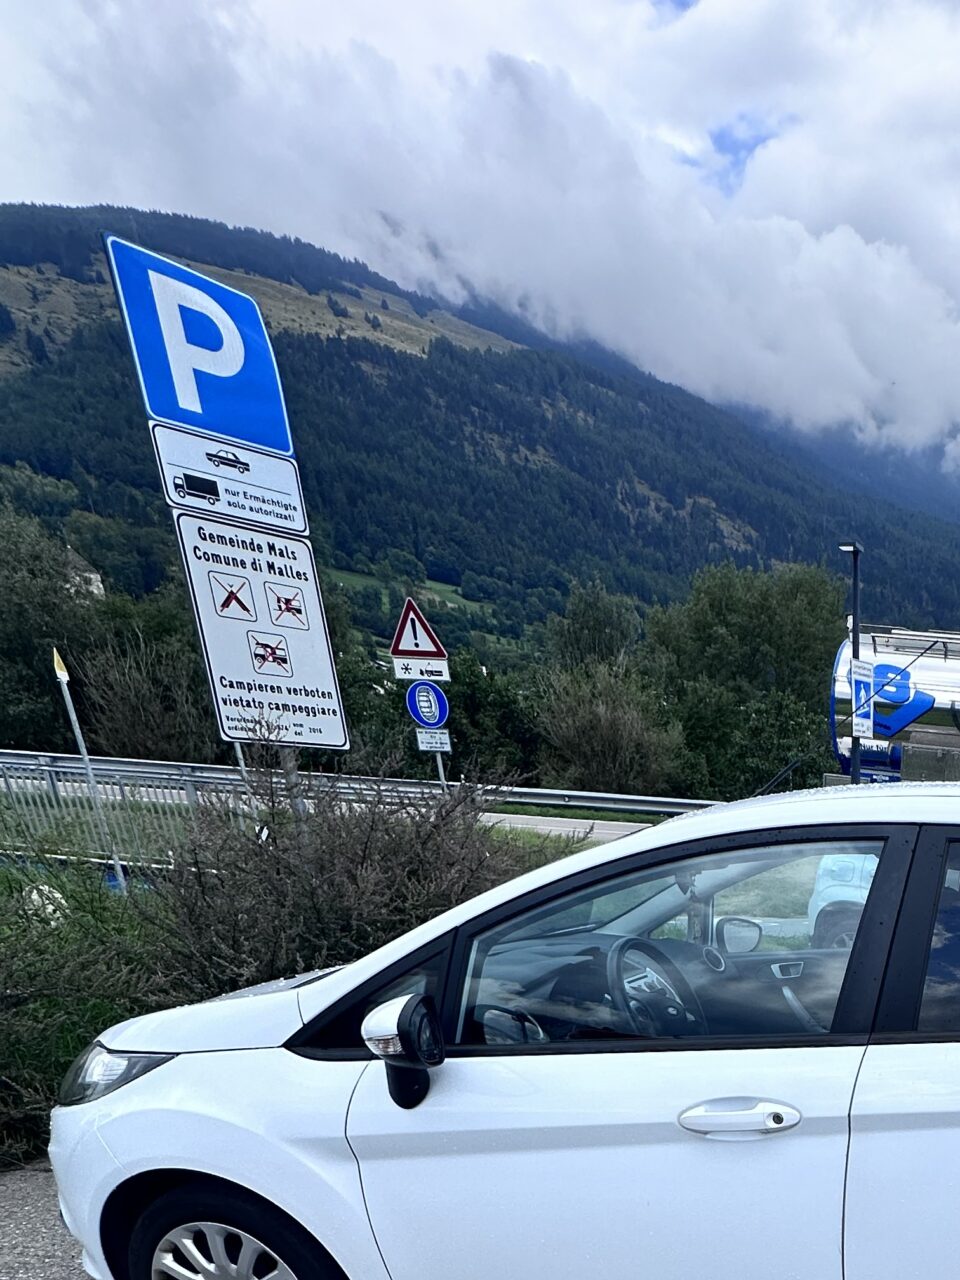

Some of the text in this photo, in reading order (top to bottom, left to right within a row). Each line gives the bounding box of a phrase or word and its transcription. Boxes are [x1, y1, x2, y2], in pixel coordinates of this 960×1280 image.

[147, 269, 245, 414] P
[224, 488, 298, 512] nur Ermächtigte
[227, 500, 296, 522] solo autorizzati
[197, 526, 297, 561] Gemeinde Mals
[193, 545, 309, 582] Comune di Malles
[219, 675, 333, 700] Campieren verboten
[221, 694, 338, 718] vietato campeggiare
